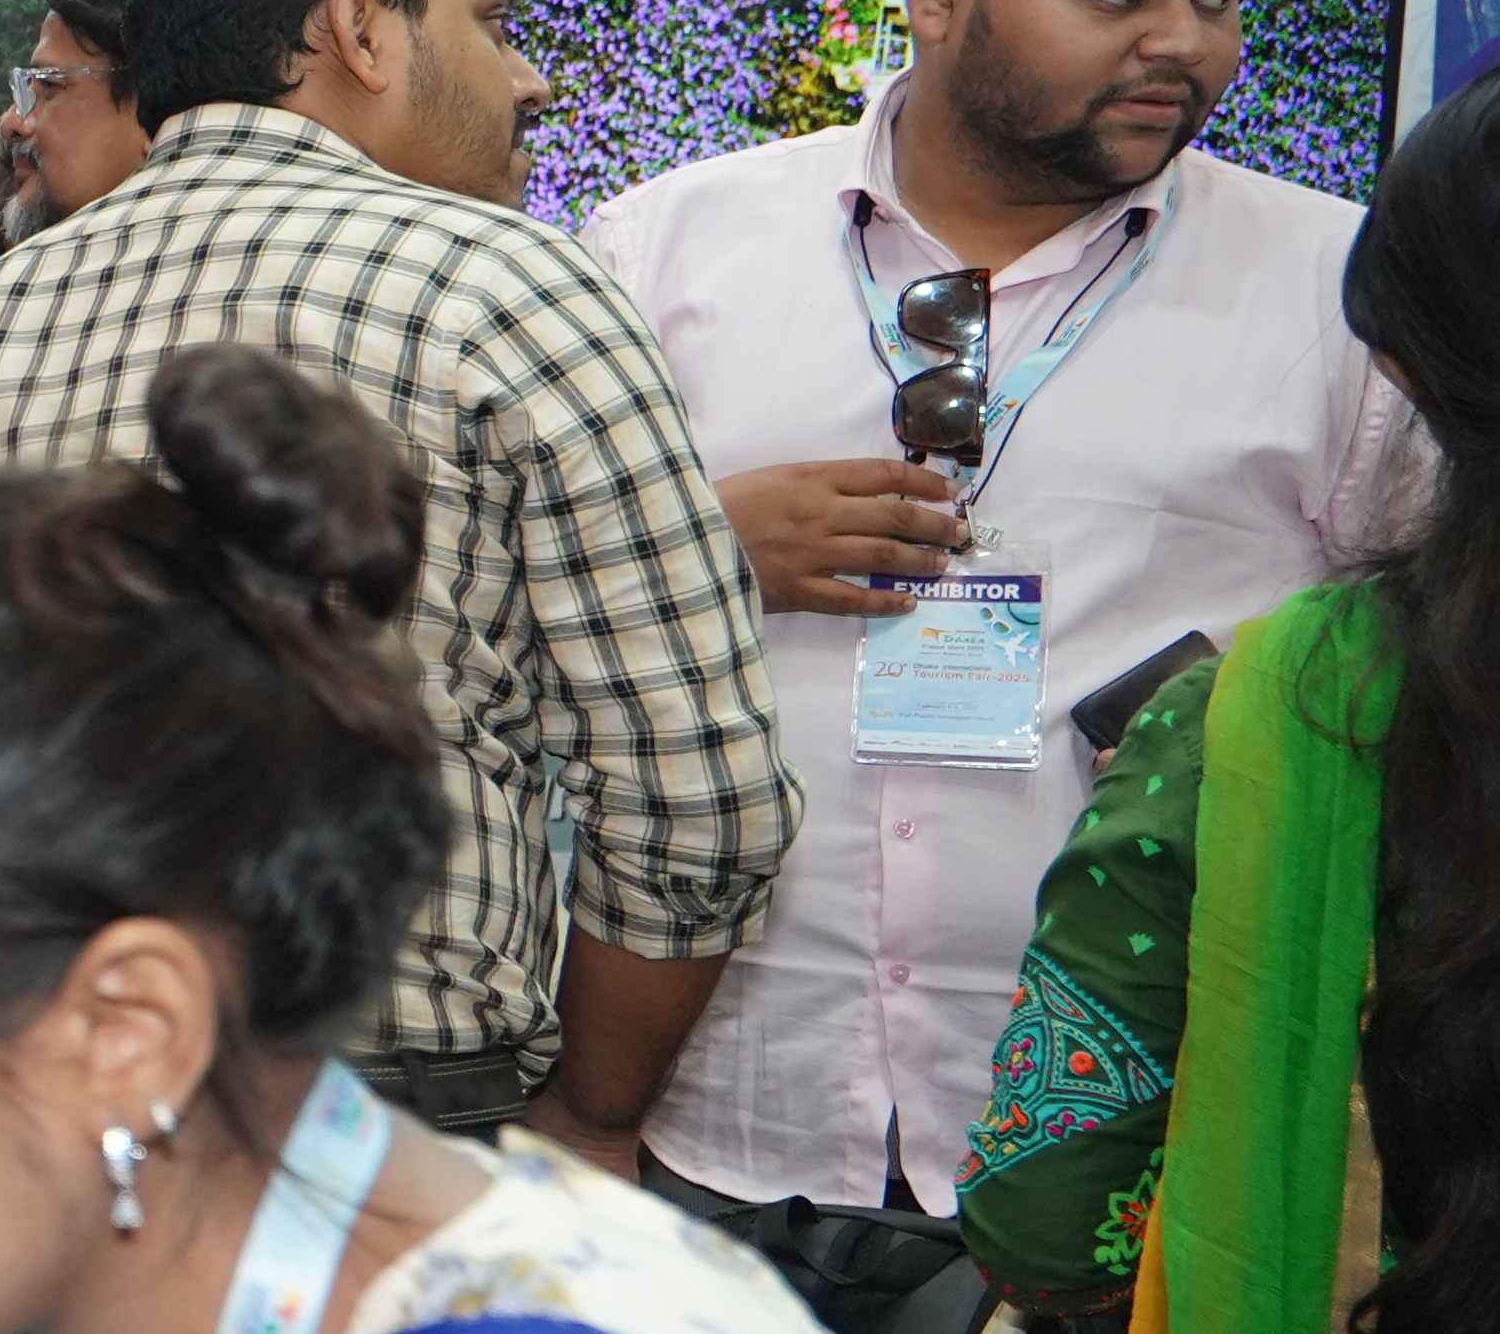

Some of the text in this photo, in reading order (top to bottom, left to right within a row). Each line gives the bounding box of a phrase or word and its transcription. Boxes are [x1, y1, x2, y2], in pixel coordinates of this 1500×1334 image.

[893, 581, 1021, 600] EXHIBITOR
[913, 671, 1031, 683] Tourism Fair-2025
